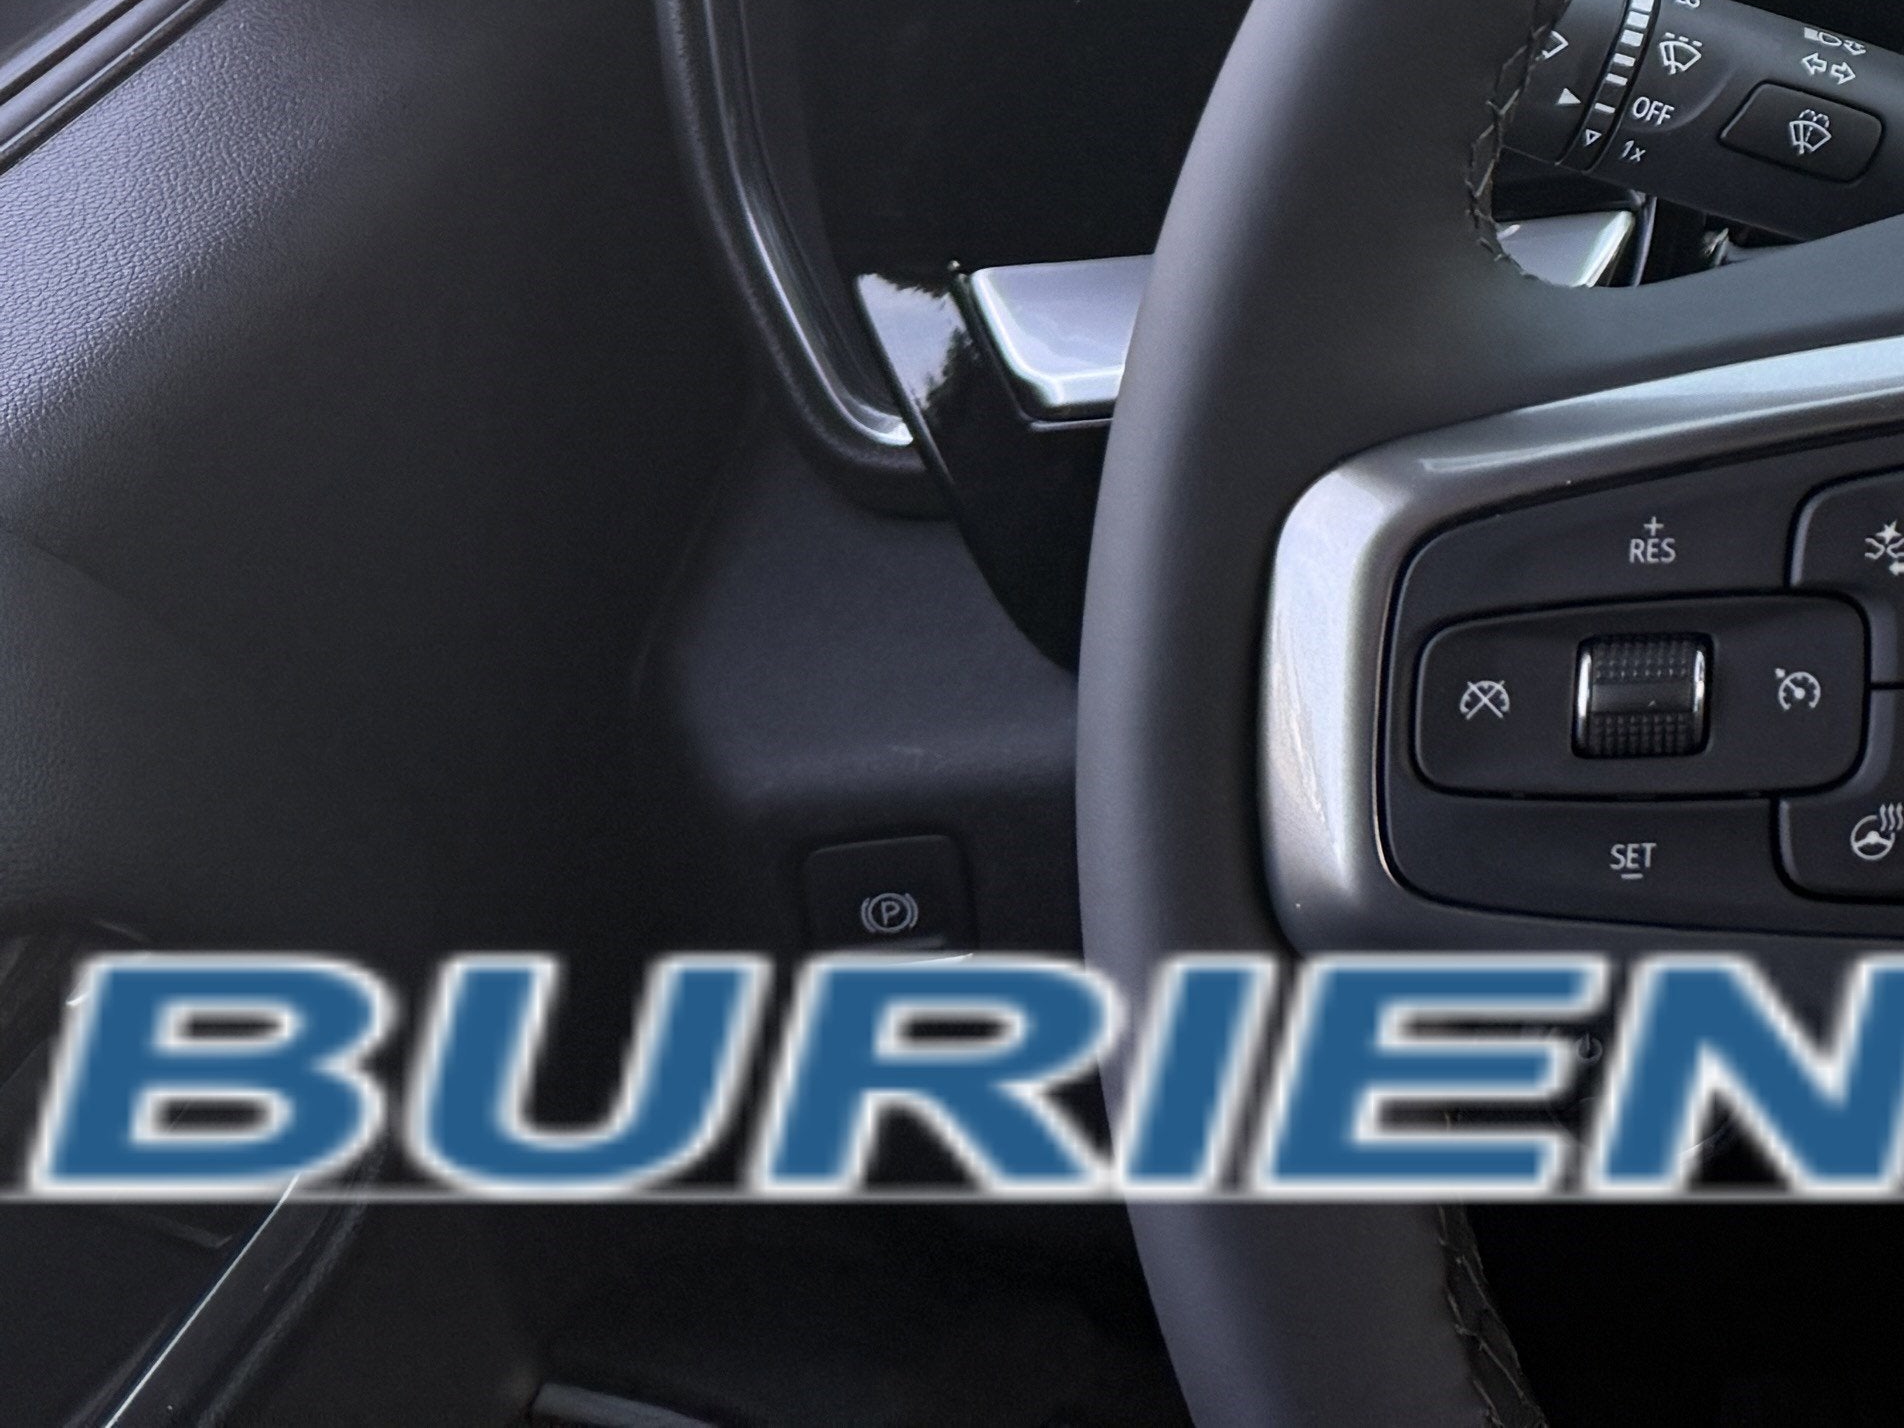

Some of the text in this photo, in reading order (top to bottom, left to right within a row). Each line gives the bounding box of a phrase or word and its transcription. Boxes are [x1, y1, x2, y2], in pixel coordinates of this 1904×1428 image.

[1631, 96, 1675, 126] OFF
[1619, 140, 1646, 162] 1x
[1629, 539, 1676, 564] RES
[1610, 842, 1656, 870] SET
